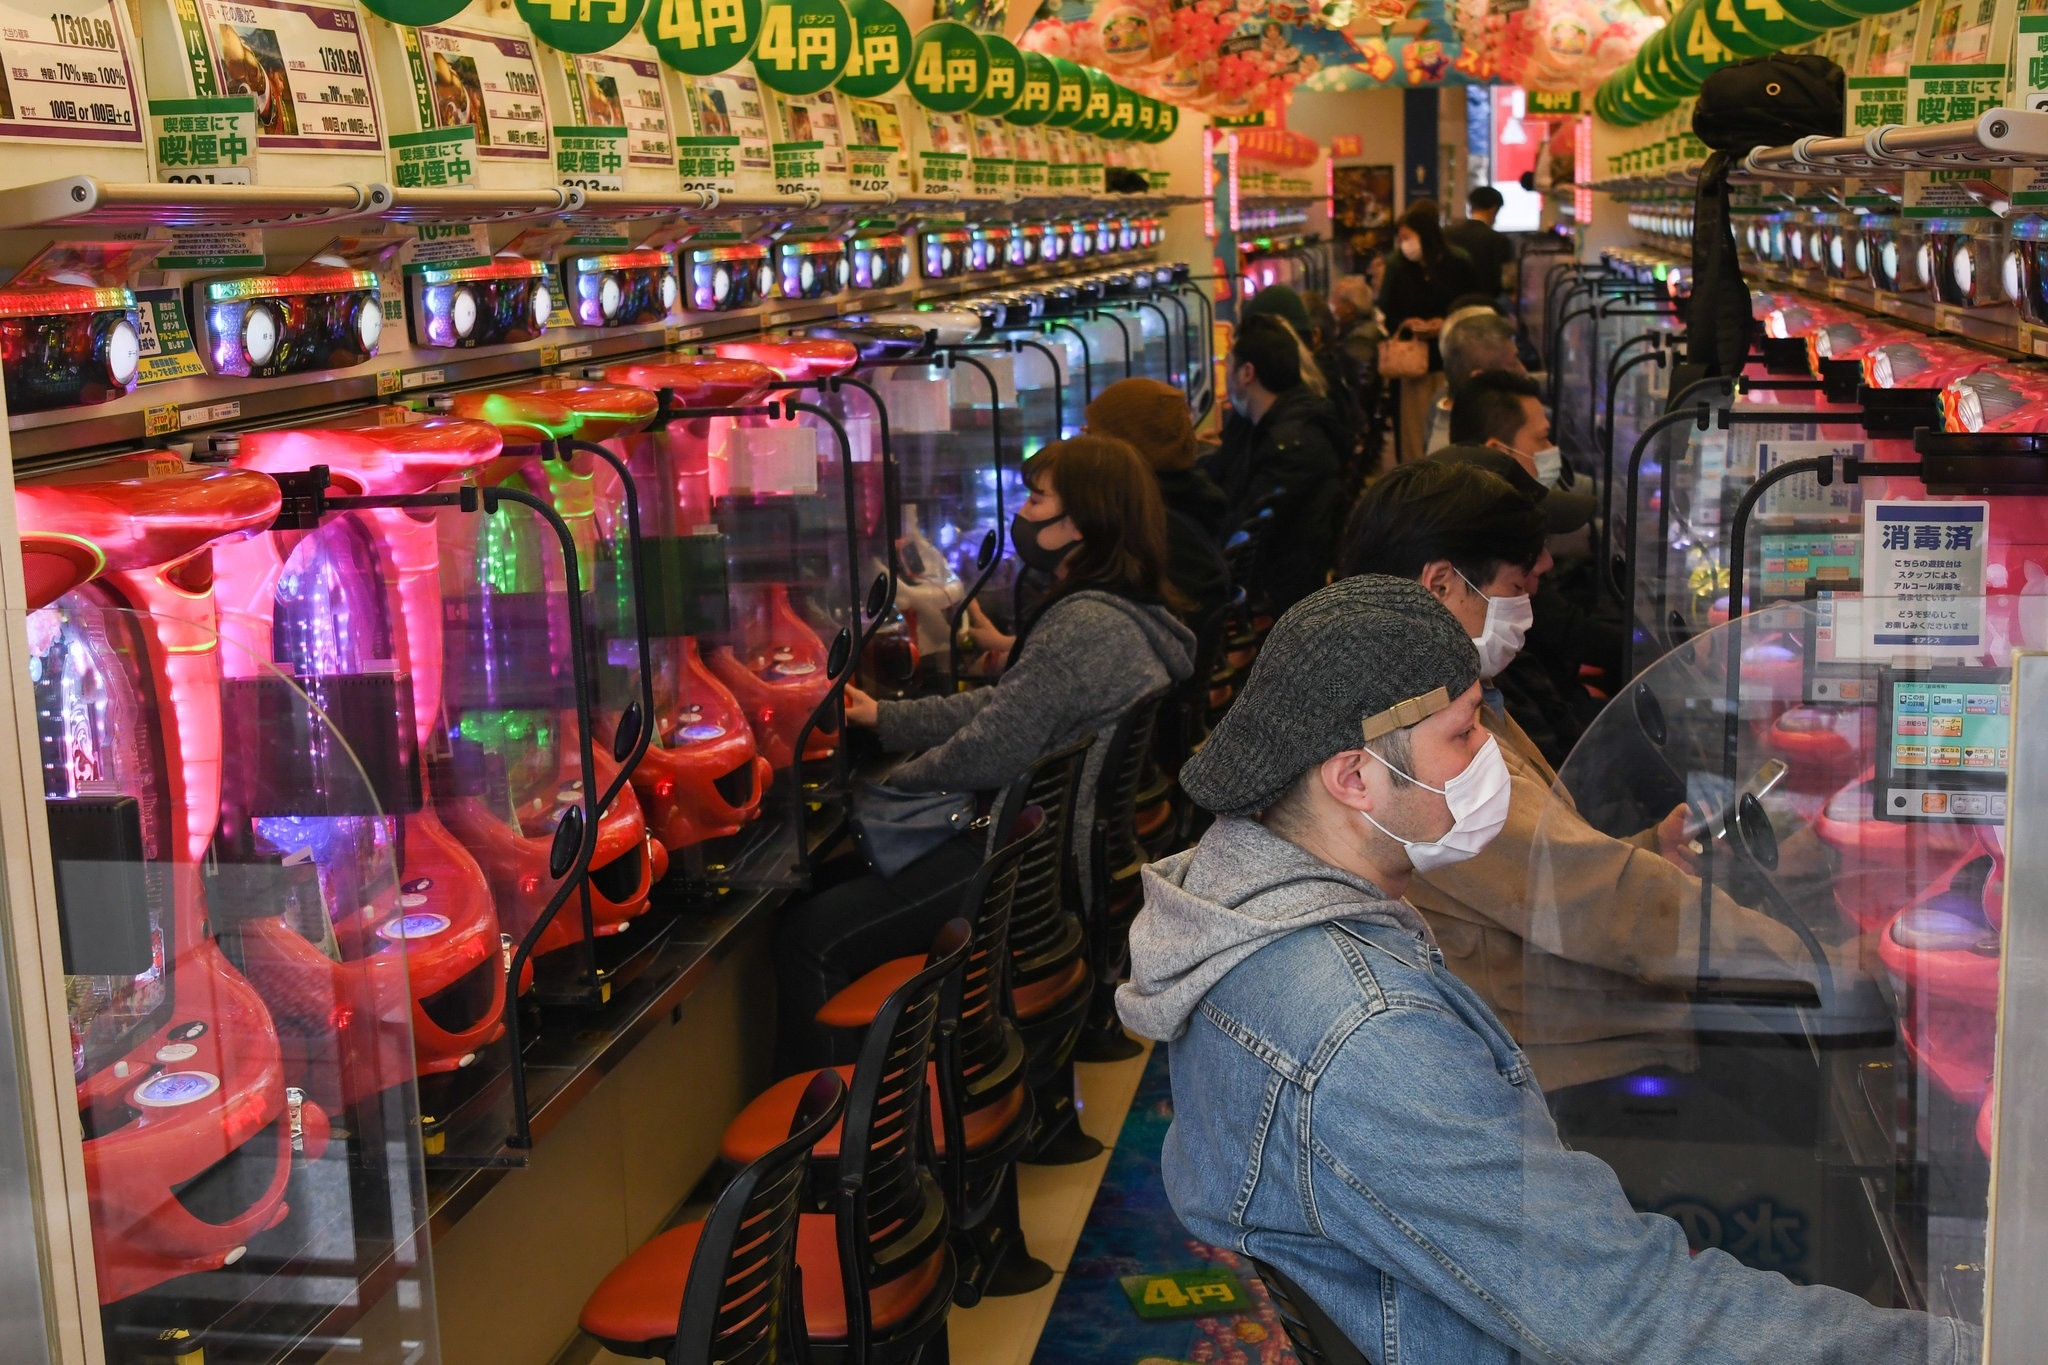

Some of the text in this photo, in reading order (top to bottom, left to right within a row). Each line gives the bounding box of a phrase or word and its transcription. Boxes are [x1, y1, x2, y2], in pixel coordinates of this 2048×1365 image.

[799, 14, 837, 25] パチンコ
[51, 13, 117, 50] 1/319.68
[757, 5, 837, 71] 4円
[862, 24, 898, 35] パチンコ
[318, 47, 363, 75] 1/319.68
[914, 41, 978, 94] 4円
[57, 62, 81, 82] 70%
[98, 67, 126, 86] 100%
[1924, 80, 2000, 95] 喫煙室にて
[49, 100, 77, 121] 100回
[78, 106, 89, 121] or
[163, 116, 239, 133] 喫煙室にて
[158, 133, 248, 167] 喫煙中
[399, 143, 463, 162] 喫煙室にて
[561, 138, 617, 150] 喫煙室にて
[557, 151, 622, 174] 喫煙中
[678, 158, 736, 178] 喫煙中
[395, 157, 472, 188] 喫煙中
[196, 257, 225, 266] オアシス
[263, 367, 276, 377] 201
[153, 415, 168, 425] STOP
[1882, 524, 1973, 551] 消毒済
[1894, 560, 1962, 569] こちらの遊技台は
[1898, 571, 1957, 580] スタッフによる
[1893, 582, 1961, 591] アルコール消毒を
[1898, 610, 1957, 619] どうぞ安心して
[1885, 621, 1969, 630] お楽しみくださいませ
[1143, 1278, 1236, 1308] 4円
